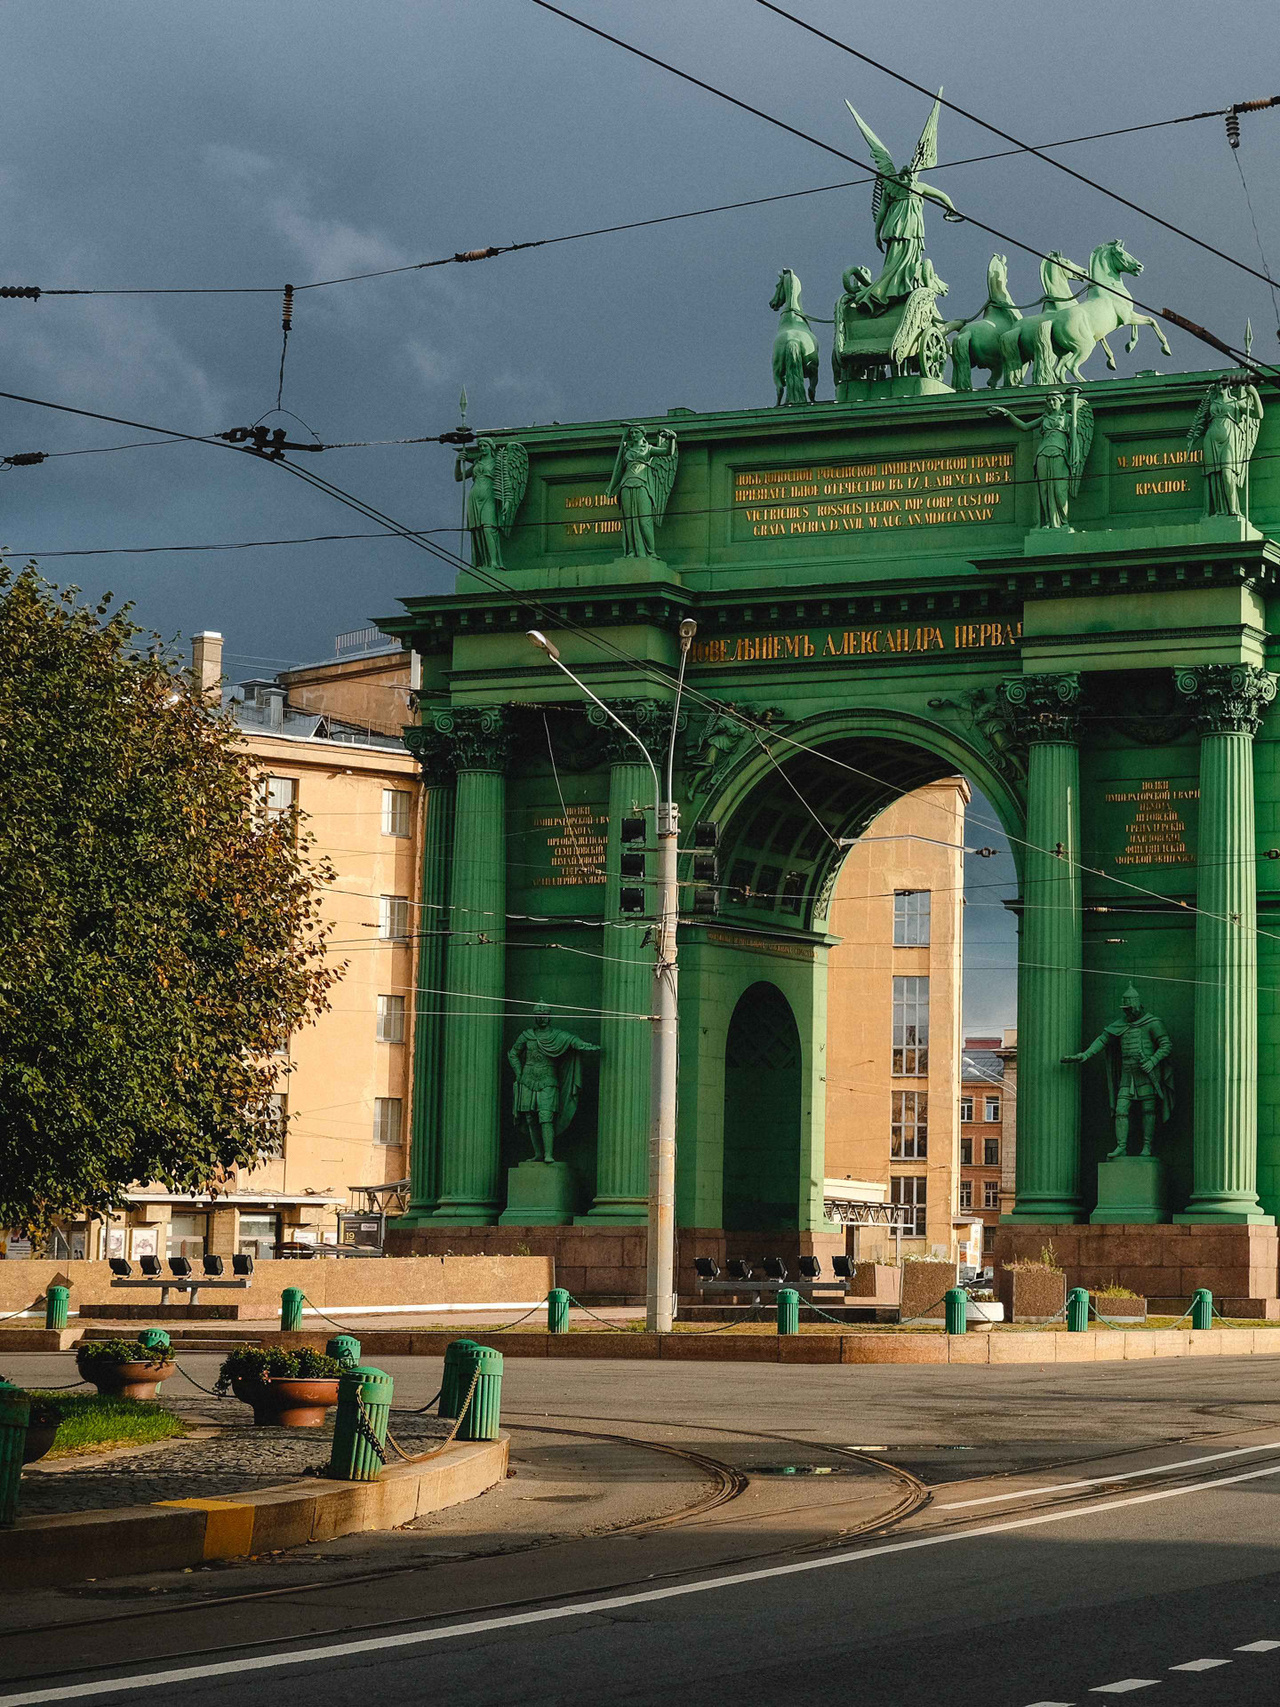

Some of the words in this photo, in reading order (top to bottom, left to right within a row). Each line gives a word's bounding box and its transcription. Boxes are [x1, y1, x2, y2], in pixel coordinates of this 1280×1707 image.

[824, 479, 885, 496] ОТЕЧЕСТВО
[746, 506, 809, 523] VICTRICIBUS
[817, 502, 862, 517] ROSSICIS
[822, 627, 945, 656] АЛЕКСАНДРА
[345, 1232, 355, 1241] 19
